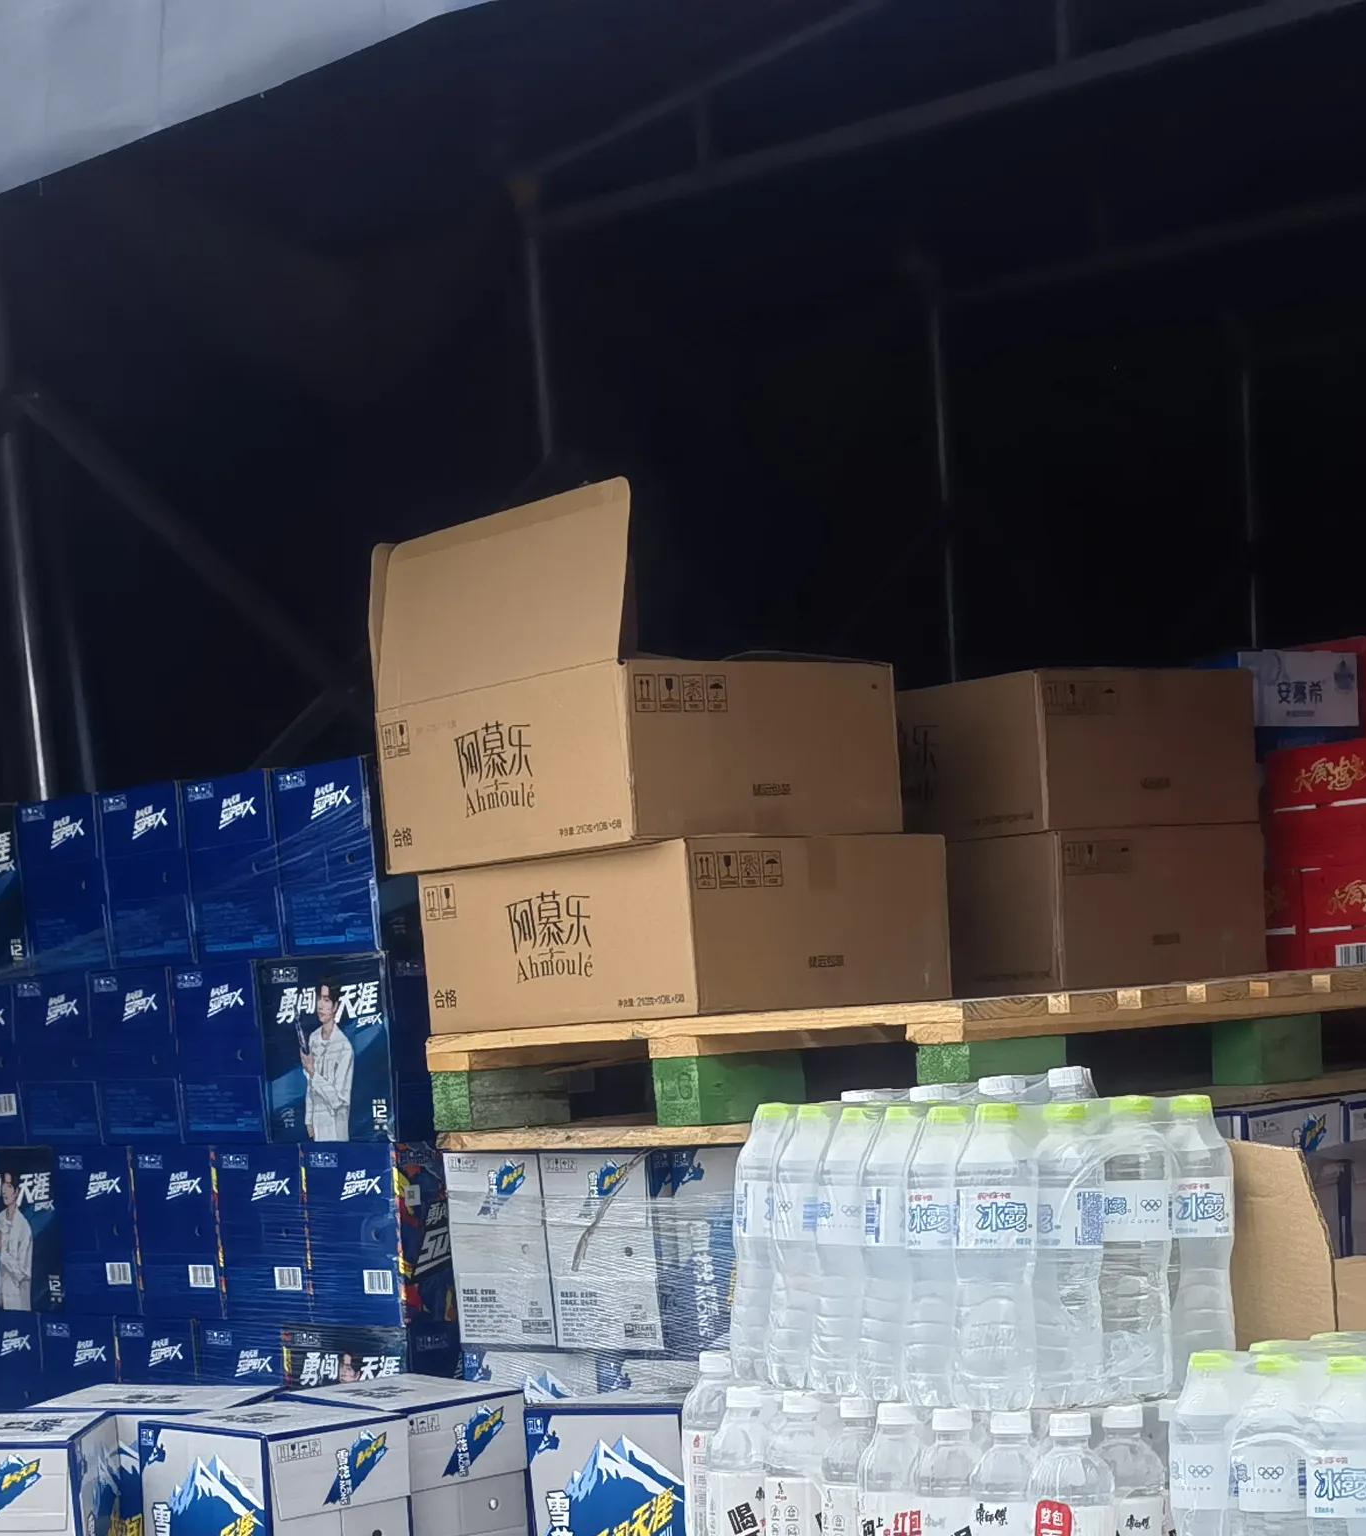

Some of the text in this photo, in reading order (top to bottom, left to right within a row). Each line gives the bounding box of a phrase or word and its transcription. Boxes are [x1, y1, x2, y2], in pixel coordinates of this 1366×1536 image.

[1277, 681, 1323, 704] 安慕希
[454, 721, 533, 787] 阿慕乐
[465, 784, 535, 818] Ahmoulé
[392, 827, 413, 848] 合格
[506, 891, 592, 953] 阿慕乐
[11, 944, 23, 957] 12
[517, 951, 594, 983] Ahmoulé
[434, 989, 457, 1008] 合格
[372, 1105, 387, 1118] 12
[976, 1202, 1028, 1233] 冰露
[1176, 1192, 1224, 1221] 冰露
